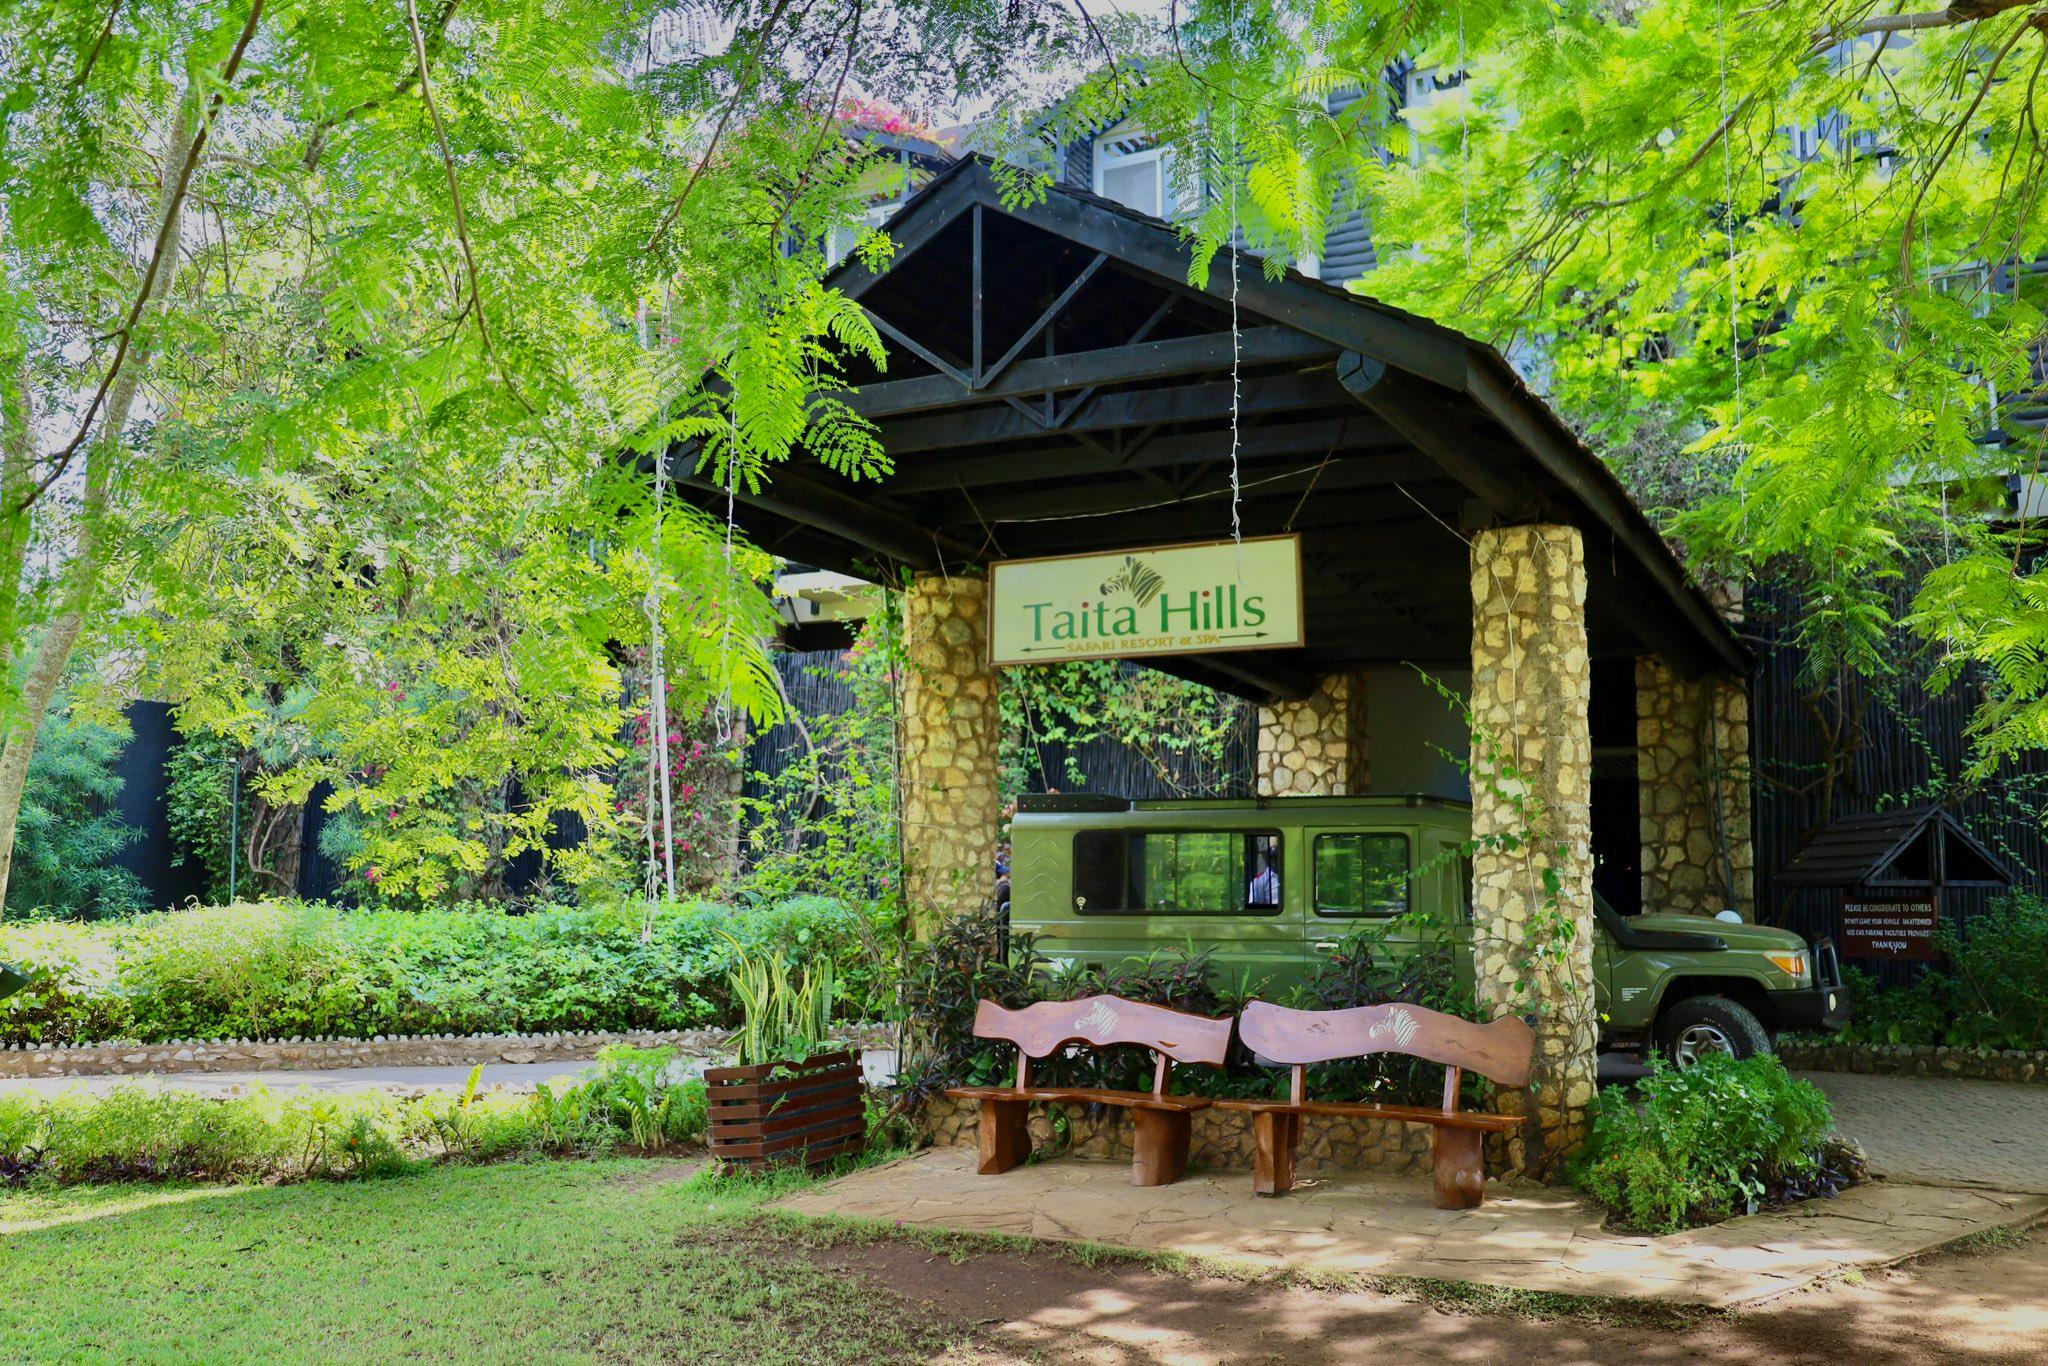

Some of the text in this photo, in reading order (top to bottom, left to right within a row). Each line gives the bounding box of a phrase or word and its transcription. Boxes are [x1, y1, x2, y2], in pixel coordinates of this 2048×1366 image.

[1023, 584, 1266, 642] Taita Hills
[1066, 633, 1220, 653] SAFARI RESORT & SPA
[1845, 904, 1932, 912] PLEASE BE CONSIDERATE TO OTHERS
[1872, 941, 1906, 954] THANK YOU
